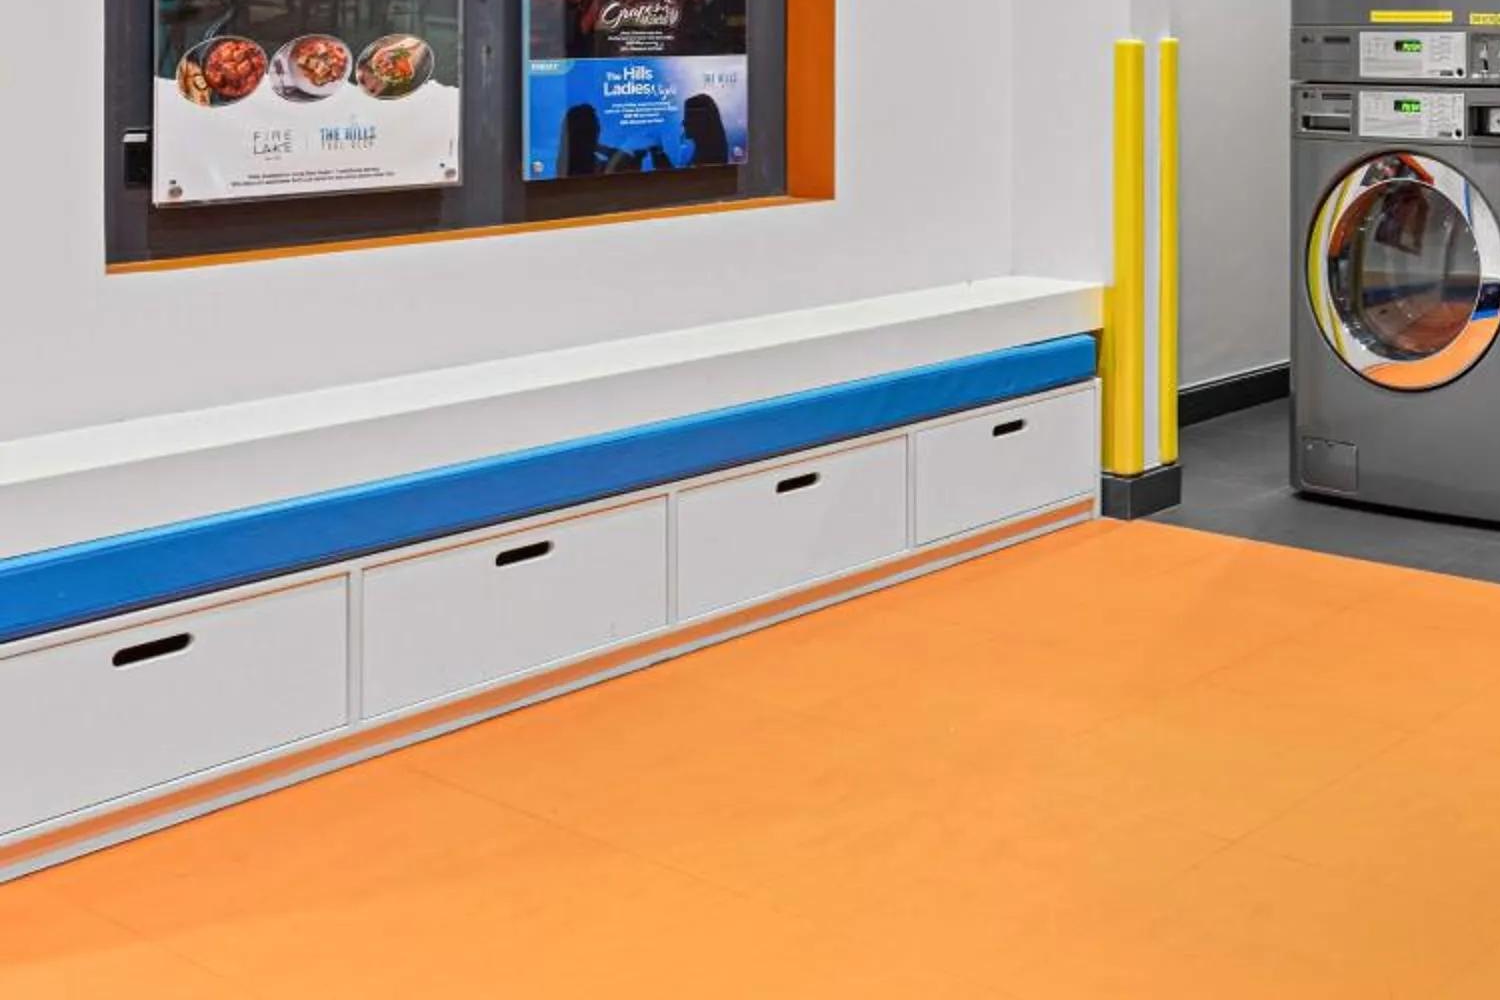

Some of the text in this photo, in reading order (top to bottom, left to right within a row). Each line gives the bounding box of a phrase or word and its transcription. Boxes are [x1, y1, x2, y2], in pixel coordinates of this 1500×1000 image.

[606, 66, 653, 81] The Hills
[604, 82, 649, 97] Ladies
[253, 128, 293, 141] FIRE
[320, 125, 377, 141] THE HILLS
[253, 142, 293, 154] LAKE
